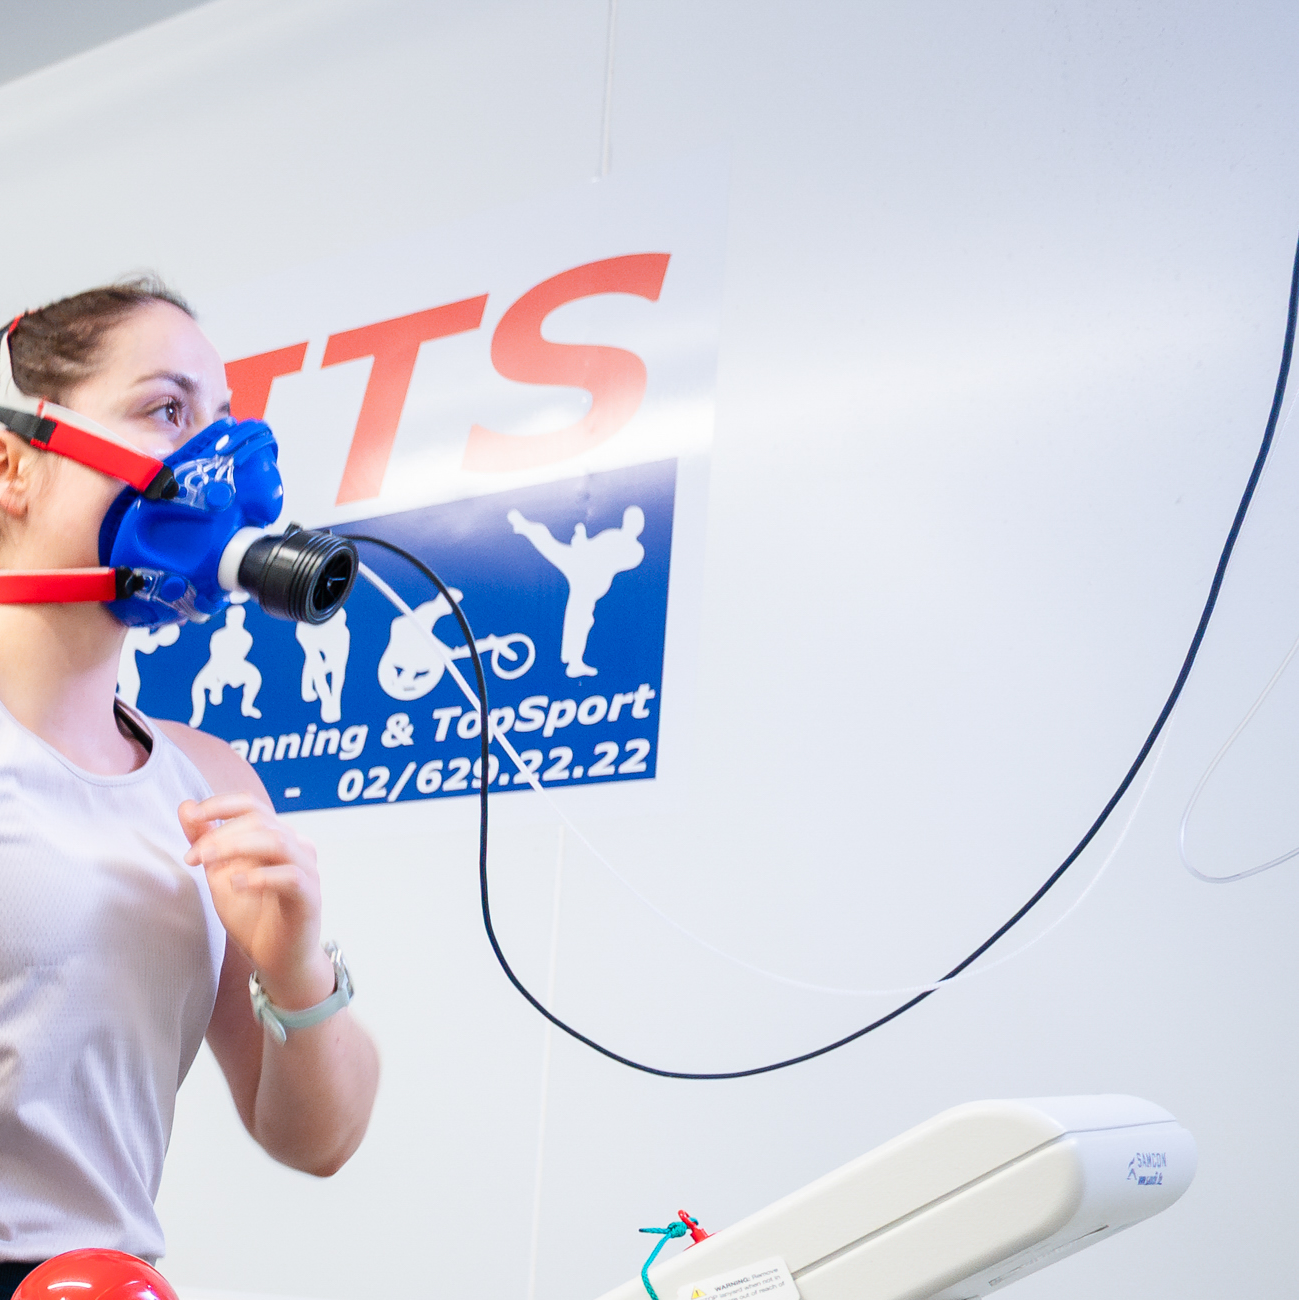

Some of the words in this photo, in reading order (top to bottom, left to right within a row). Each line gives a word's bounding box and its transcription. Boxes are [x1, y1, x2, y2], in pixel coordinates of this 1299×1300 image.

[229, 723, 368, 764] anning
[381, 712, 415, 748] &
[432, 682, 656, 744] TopSport
[336, 738, 653, 803] 02/629.22.22
[714, 1276, 751, 1292] WARNING:
[751, 1267, 779, 1281] Remove
[719, 1287, 743, 1300] lanyard
[744, 1281, 762, 1291] when
[762, 1277, 774, 1286] not
[739, 1292, 751, 1300] out
[759, 1284, 778, 1295] reach
